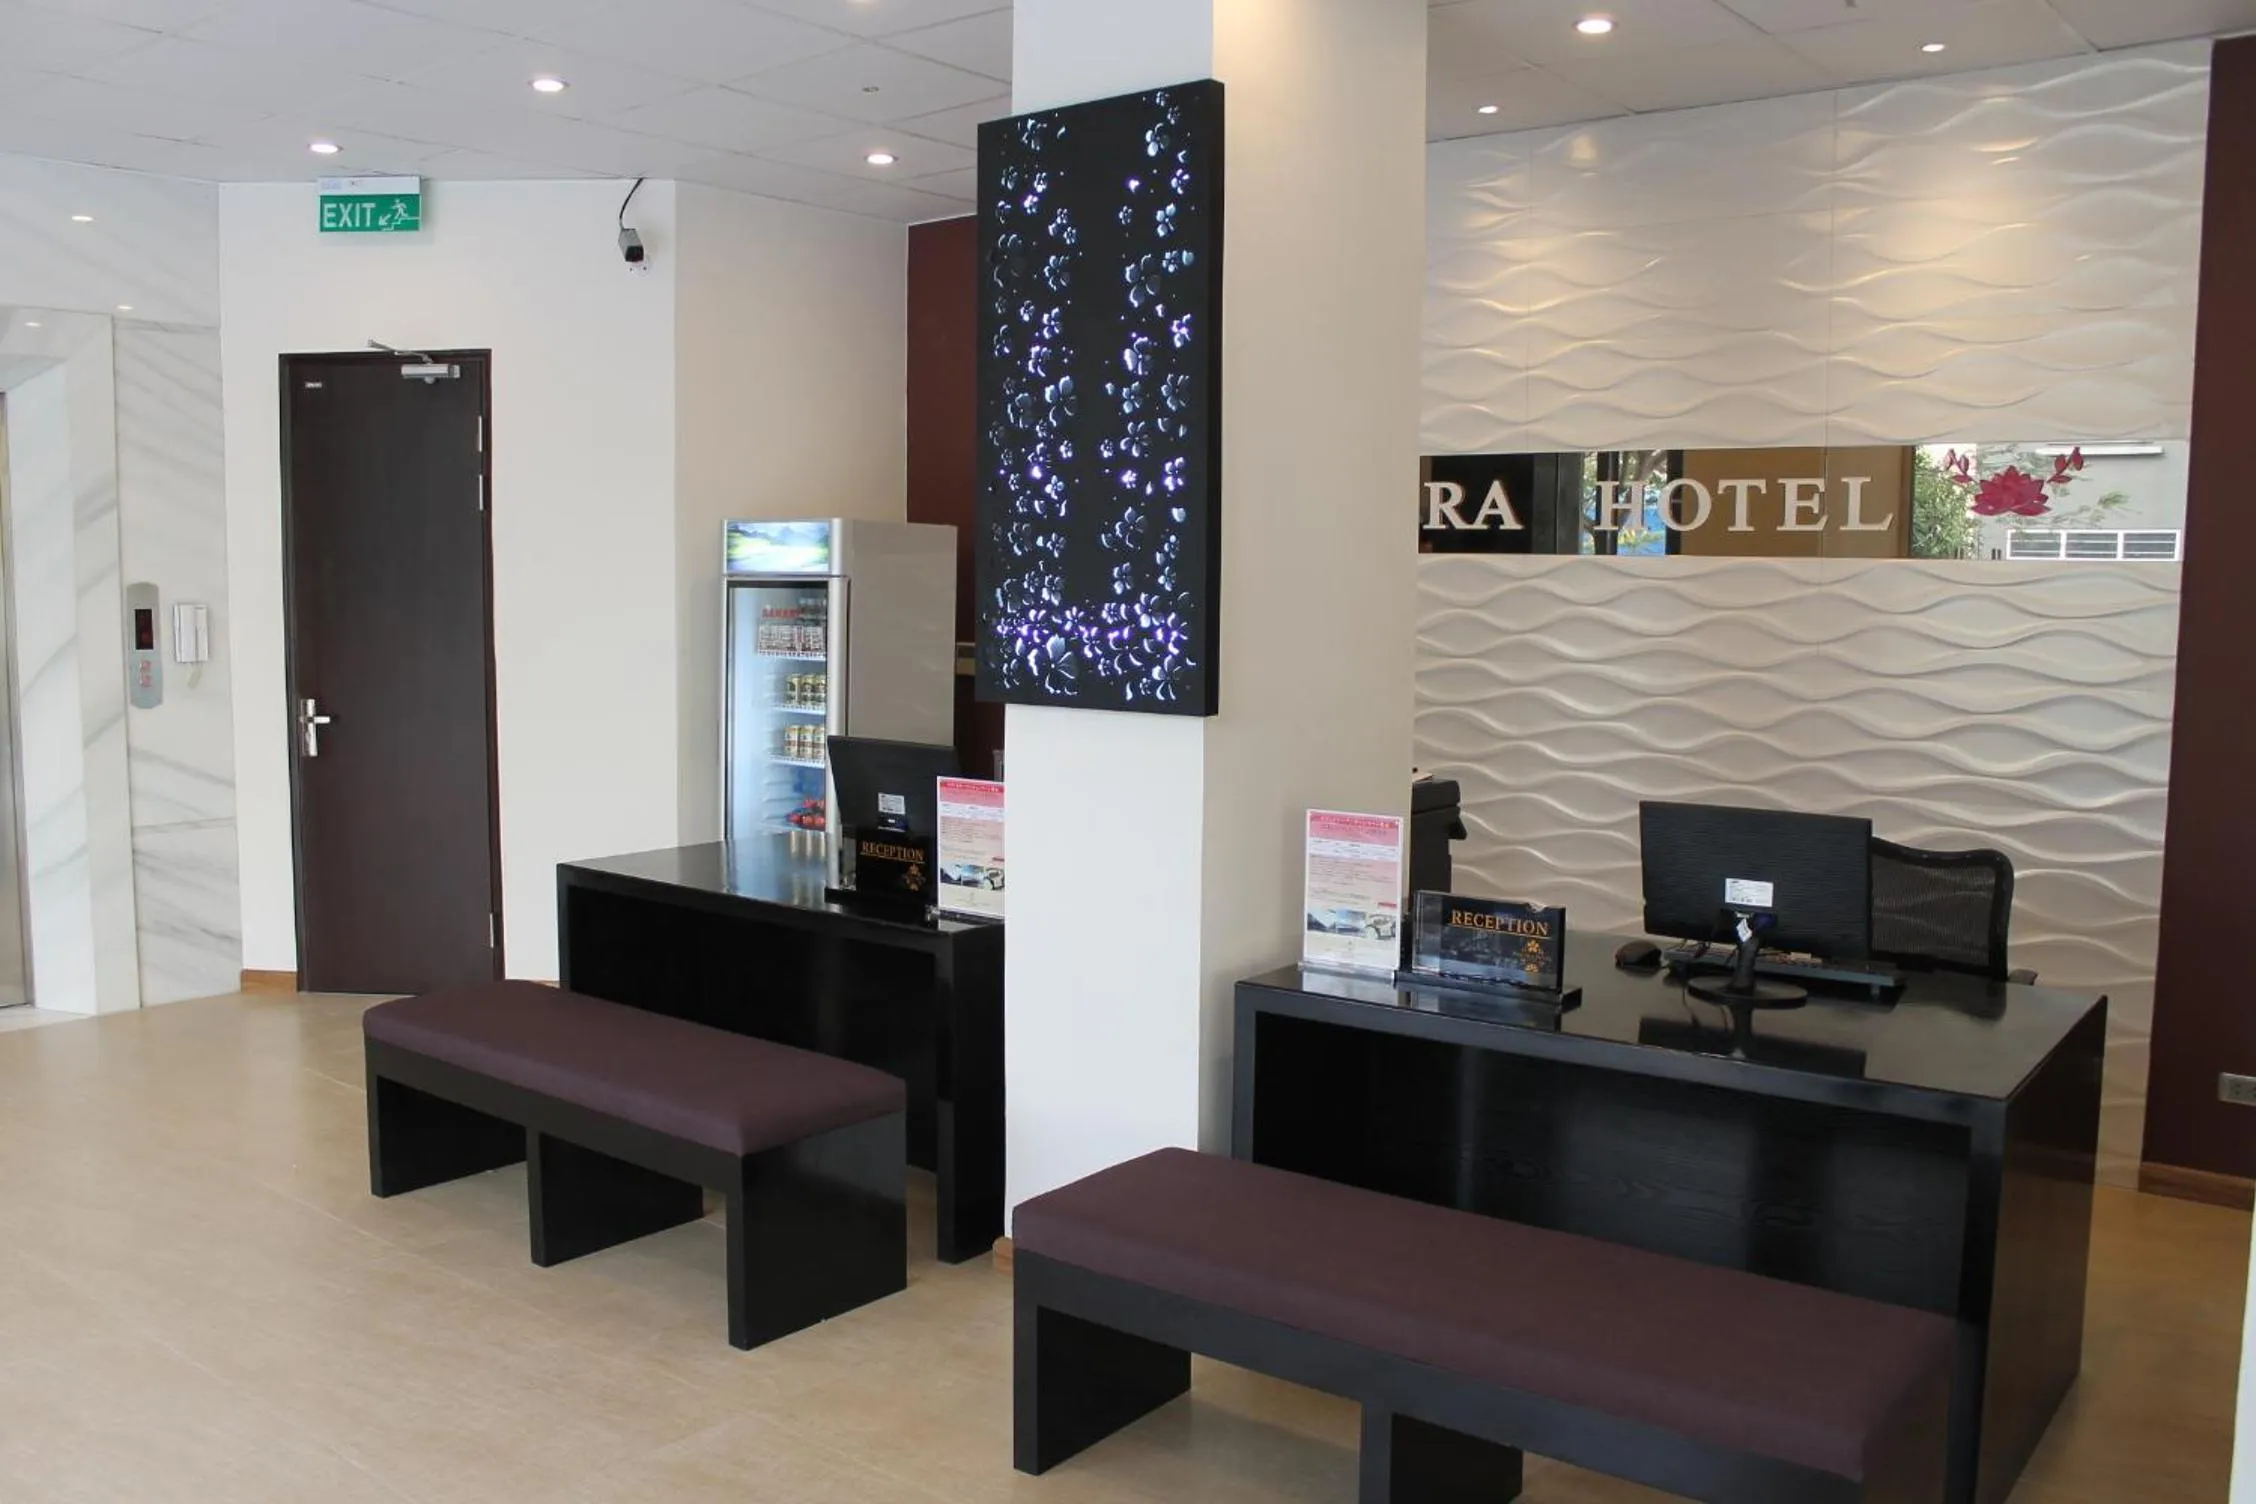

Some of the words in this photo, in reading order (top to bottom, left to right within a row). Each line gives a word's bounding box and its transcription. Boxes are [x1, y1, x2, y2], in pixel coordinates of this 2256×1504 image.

[323, 203, 376, 228] EXIT
[1592, 476, 1894, 532] HOTEL
[862, 840, 925, 861] RECEPTION
[1451, 908, 1550, 936] RECEPTION
